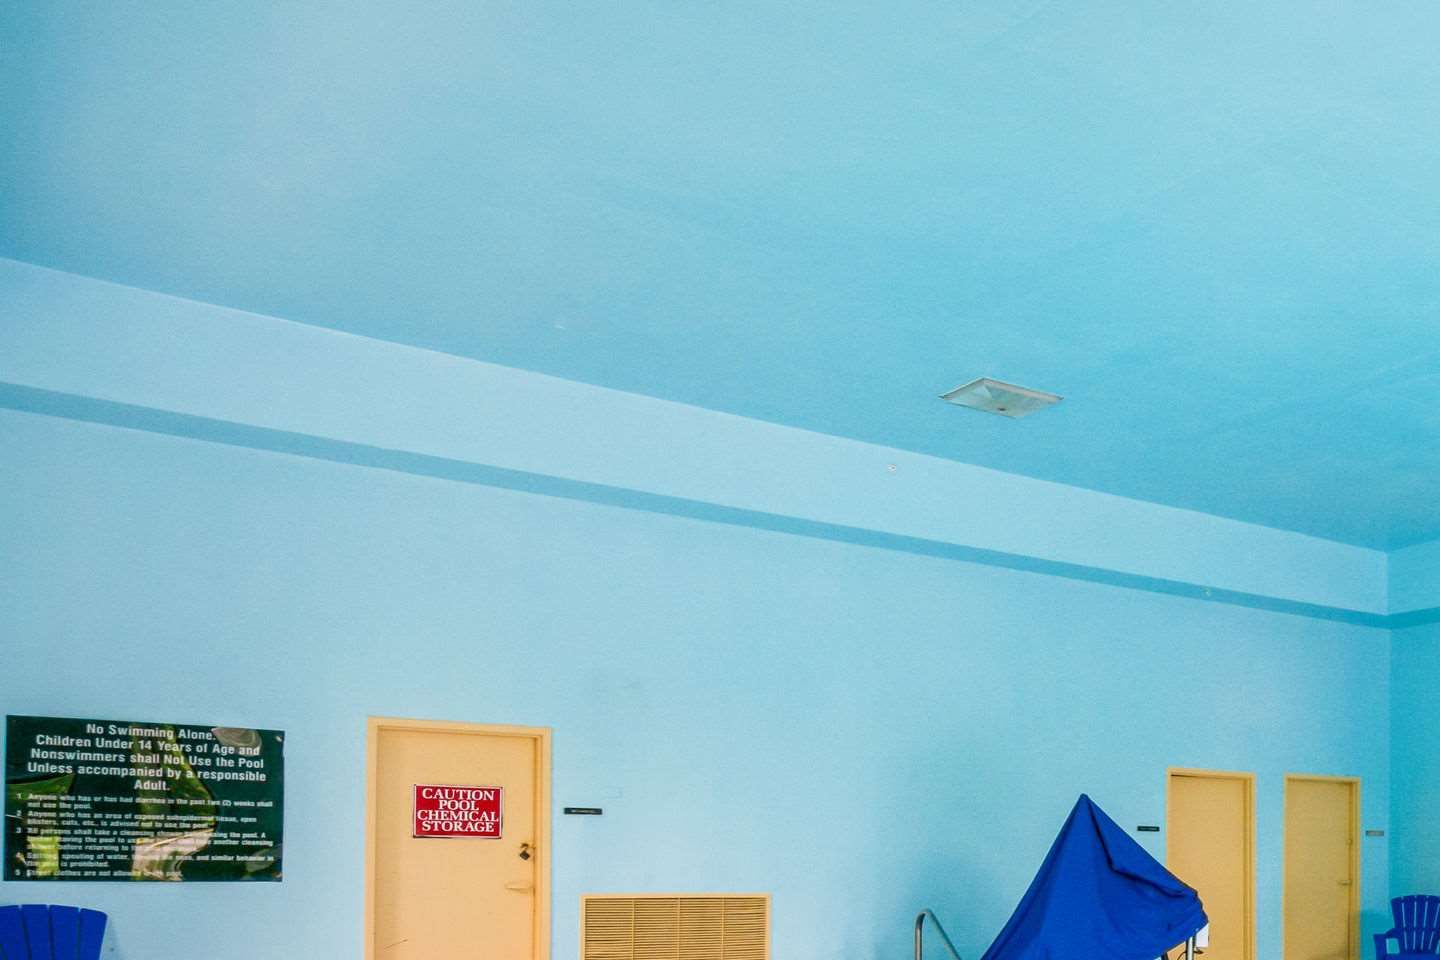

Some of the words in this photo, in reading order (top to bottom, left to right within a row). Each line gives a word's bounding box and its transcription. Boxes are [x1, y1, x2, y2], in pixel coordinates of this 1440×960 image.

[86, 723, 104, 735] No
[108, 724, 174, 740] Swimming
[178, 728, 217, 741] Alone.
[36, 734, 91, 747] Children
[95, 737, 134, 749] Under
[138, 740, 152, 750] 14
[158, 740, 192, 753] Years
[195, 743, 208, 753] of
[212, 744, 235, 756] Age
[238, 745, 260, 756] and
[30, 748, 125, 763] Nonswimmers
[130, 753, 160, 764] shall
[163, 754, 185, 766] Not
[188, 755, 212, 767] Use
[215, 757, 235, 768] the
[238, 757, 264, 769] Pool
[27, 761, 73, 774] Unless
[77, 764, 163, 778] accompanied
[167, 767, 181, 780] by
[186, 769, 195, 778] a
[197, 770, 267, 782] responsible
[133, 779, 170, 791] Adult.
[422, 788, 495, 800] CAUTION
[438, 799, 480, 811] POOL
[416, 809, 499, 822] CHEMICAL
[422, 820, 494, 832] STORAGE
